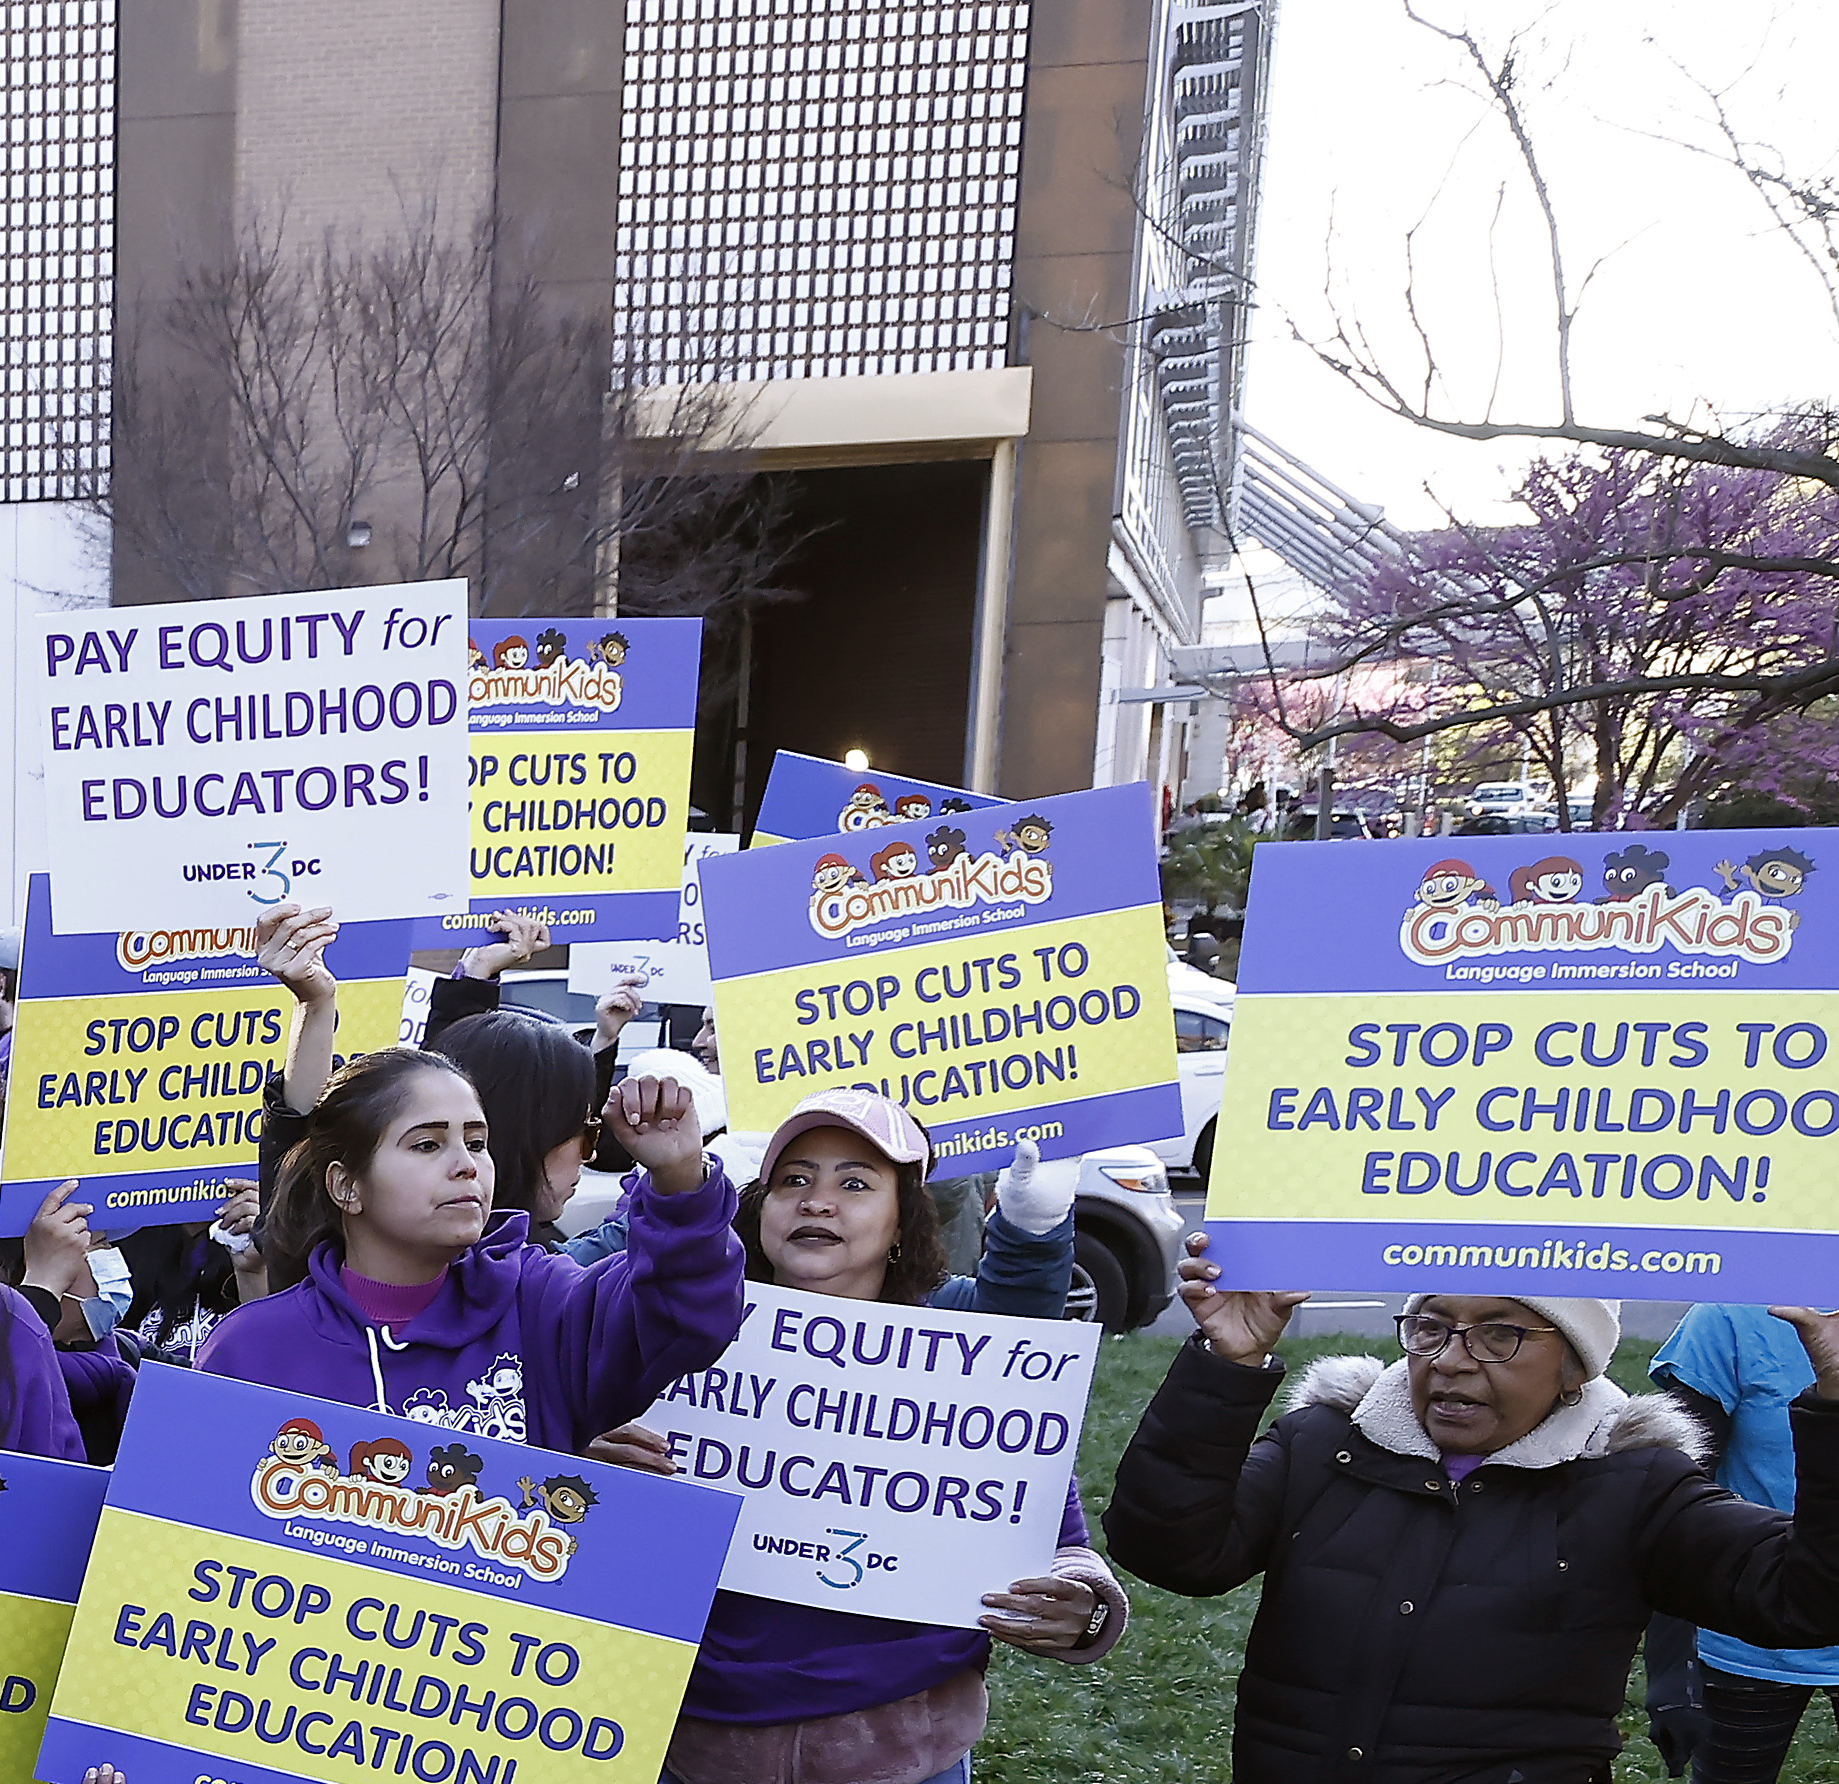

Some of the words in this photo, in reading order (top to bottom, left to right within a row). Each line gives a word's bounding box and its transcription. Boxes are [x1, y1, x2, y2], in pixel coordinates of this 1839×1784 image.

[46, 627, 139, 678] PAY
[159, 609, 366, 673] EQUITY
[381, 607, 453, 654] for
[51, 698, 172, 752] EARLY
[187, 679, 458, 745] CHILDHOOD
[81, 756, 431, 822] EDUCATORS!
[483, 797, 667, 834] CHILDHOOD
[182, 860, 257, 884] UNDER
[247, 840, 291, 904] 3
[291, 857, 322, 878] DC
[814, 855, 1048, 934] CommuniKids
[1409, 888, 1785, 958] CommuniKids
[795, 975, 900, 1026] STOP
[914, 953, 1020, 1003] CUTS
[1033, 942, 1089, 982] TO
[1446, 964, 1546, 983] Language
[1551, 963, 1661, 978] Immersion
[1666, 960, 1737, 977] School
[85, 1016, 180, 1056] STOP
[190, 1009, 281, 1048] CUTS
[754, 1029, 874, 1084] EARLY
[889, 985, 1141, 1059] CHILDHOOD
[1345, 1021, 1513, 1068] STOP
[1534, 1021, 1707, 1068] CUTS
[1736, 1021, 1827, 1069] TO
[1266, 1086, 1455, 1131] EARLY
[1361, 1150, 1770, 1202] EDUCATION!
[1383, 1241, 1721, 1273] communikids.com
[771, 1307, 992, 1377] EQUITY
[1002, 1339, 1081, 1383] for
[786, 1382, 1070, 1457] CHILDHOOD
[666, 1430, 1029, 1524] EDUCATORS!
[258, 1458, 566, 1576] CommuniKids
[284, 1520, 367, 1553] Language
[370, 1540, 460, 1575] Immersion
[463, 1563, 522, 1589] School
[753, 1533, 829, 1563] UNDER
[816, 1527, 869, 1588] 3
[866, 1551, 899, 1573] DC
[188, 1559, 331, 1624] STOP
[346, 1597, 488, 1665] CUTS
[510, 1632, 580, 1686] TO
[113, 1603, 276, 1676] EARLY
[289, 1647, 625, 1761] CHILDHOOD
